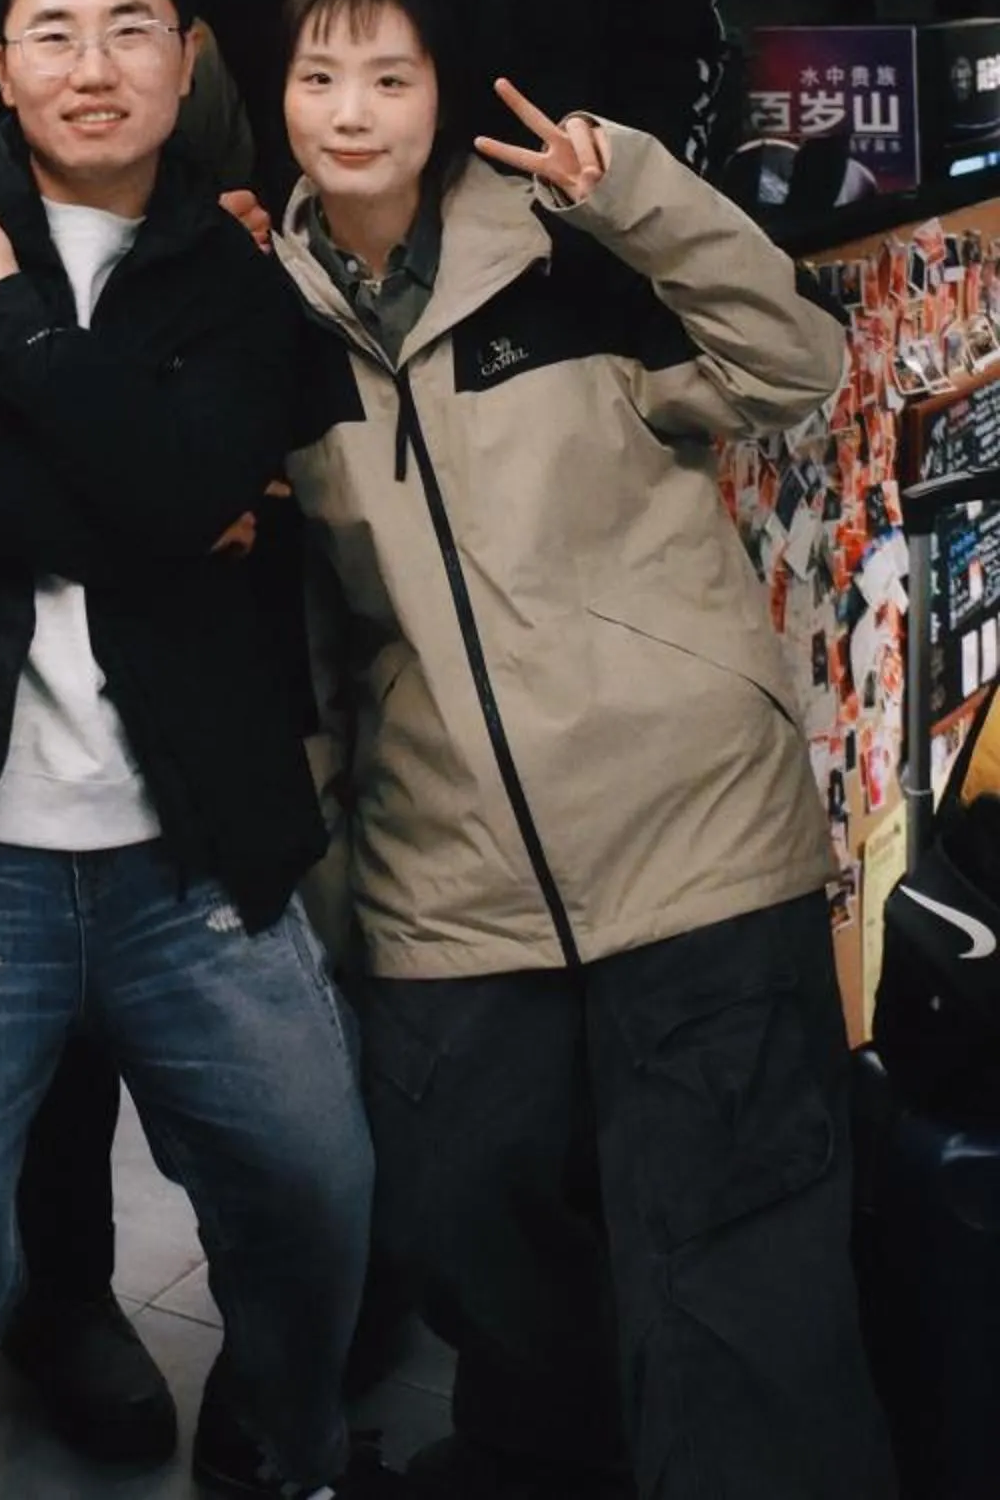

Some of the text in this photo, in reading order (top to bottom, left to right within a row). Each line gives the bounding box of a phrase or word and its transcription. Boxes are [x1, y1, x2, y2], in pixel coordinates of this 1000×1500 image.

[800, 65, 897, 87] 水中贵族
[748, 90, 900, 133] 百岁山
